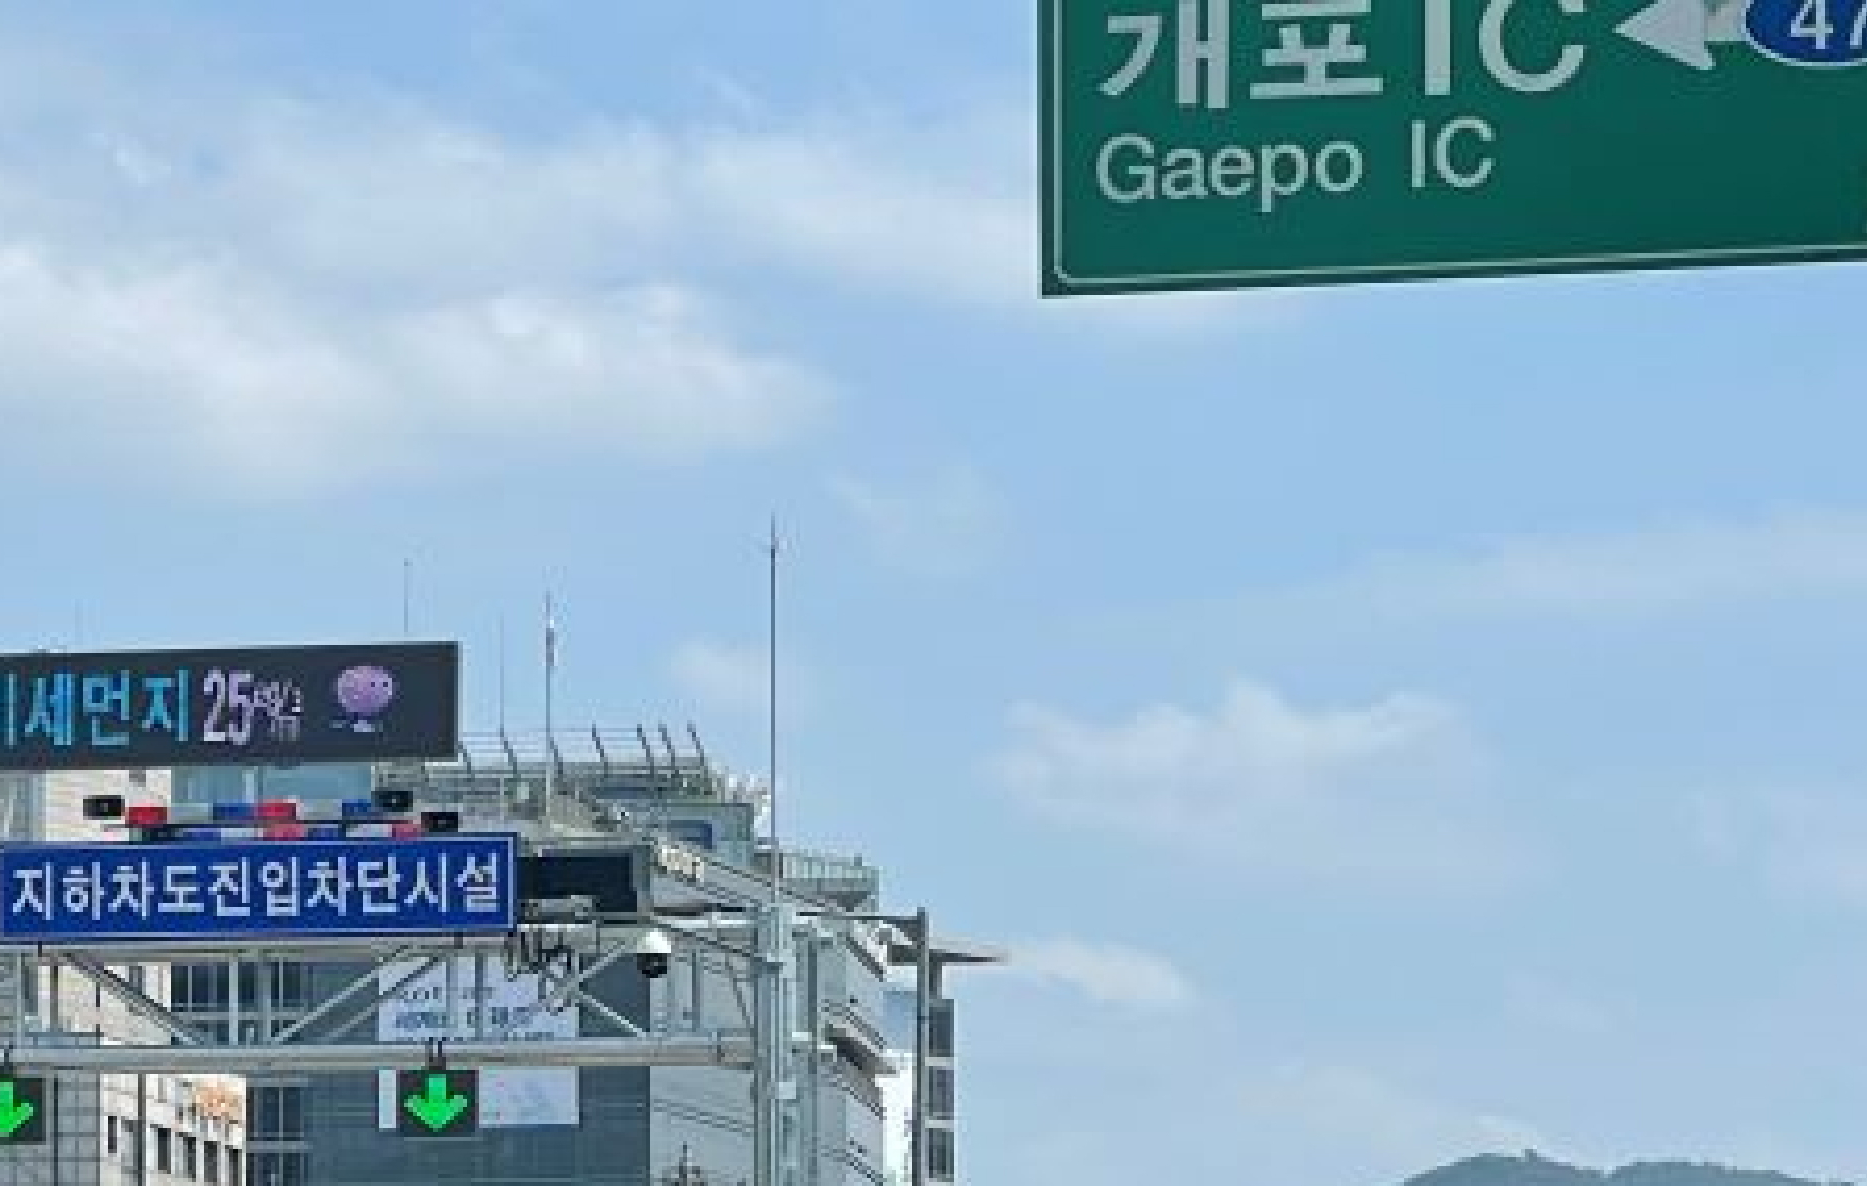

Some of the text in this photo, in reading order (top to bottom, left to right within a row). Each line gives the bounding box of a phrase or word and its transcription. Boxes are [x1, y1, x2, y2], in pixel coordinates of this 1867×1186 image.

[1099, 0, 1585, 108] 개포 IC
[1095, 114, 1495, 213] Gaepo IC
[12, 850, 499, 921] 지하차도진입차단시설
